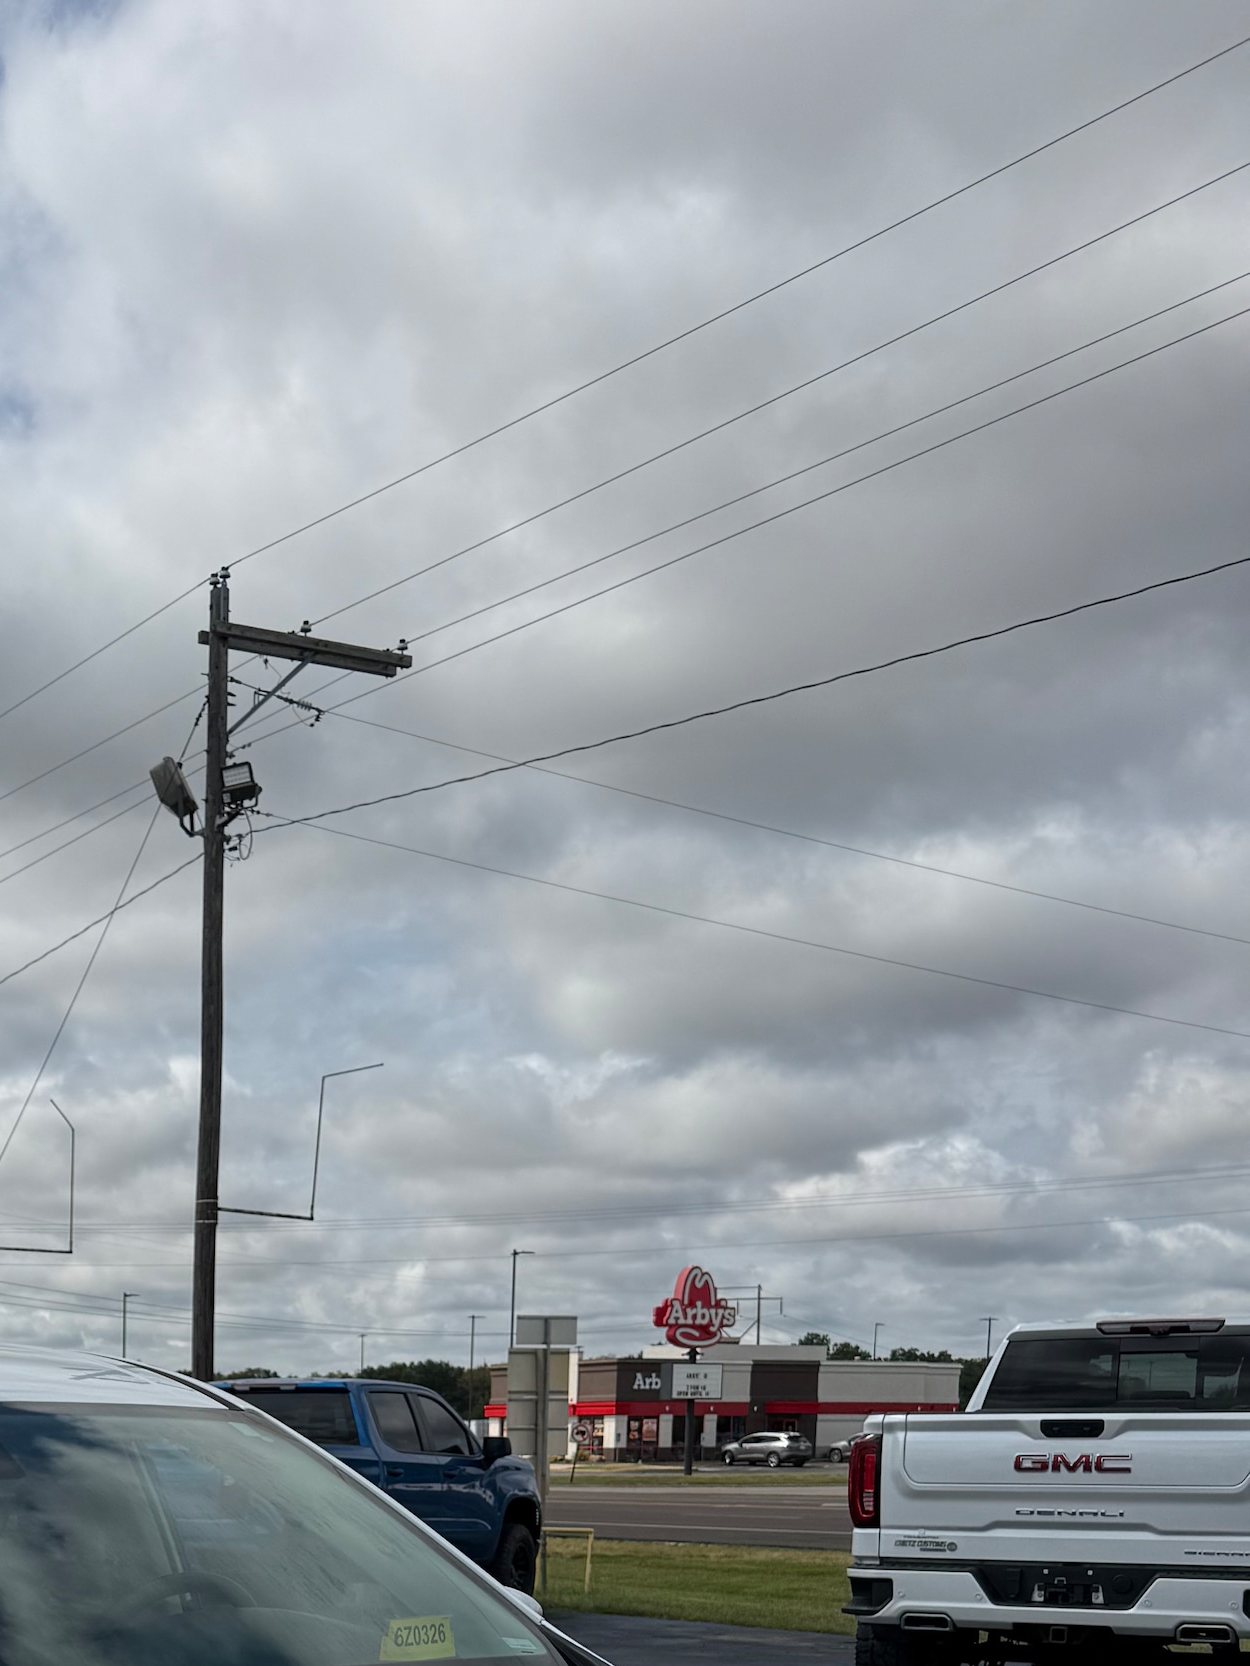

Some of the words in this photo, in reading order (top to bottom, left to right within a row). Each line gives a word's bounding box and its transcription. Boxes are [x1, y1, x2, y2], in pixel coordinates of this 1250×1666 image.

[668, 1299, 734, 1331] Arby's
[632, 1372, 662, 1390] Arb
[1013, 1452, 1133, 1474] GMC
[1015, 1507, 1125, 1518] DENALI
[394, 1623, 446, 1647] 6Z0326
